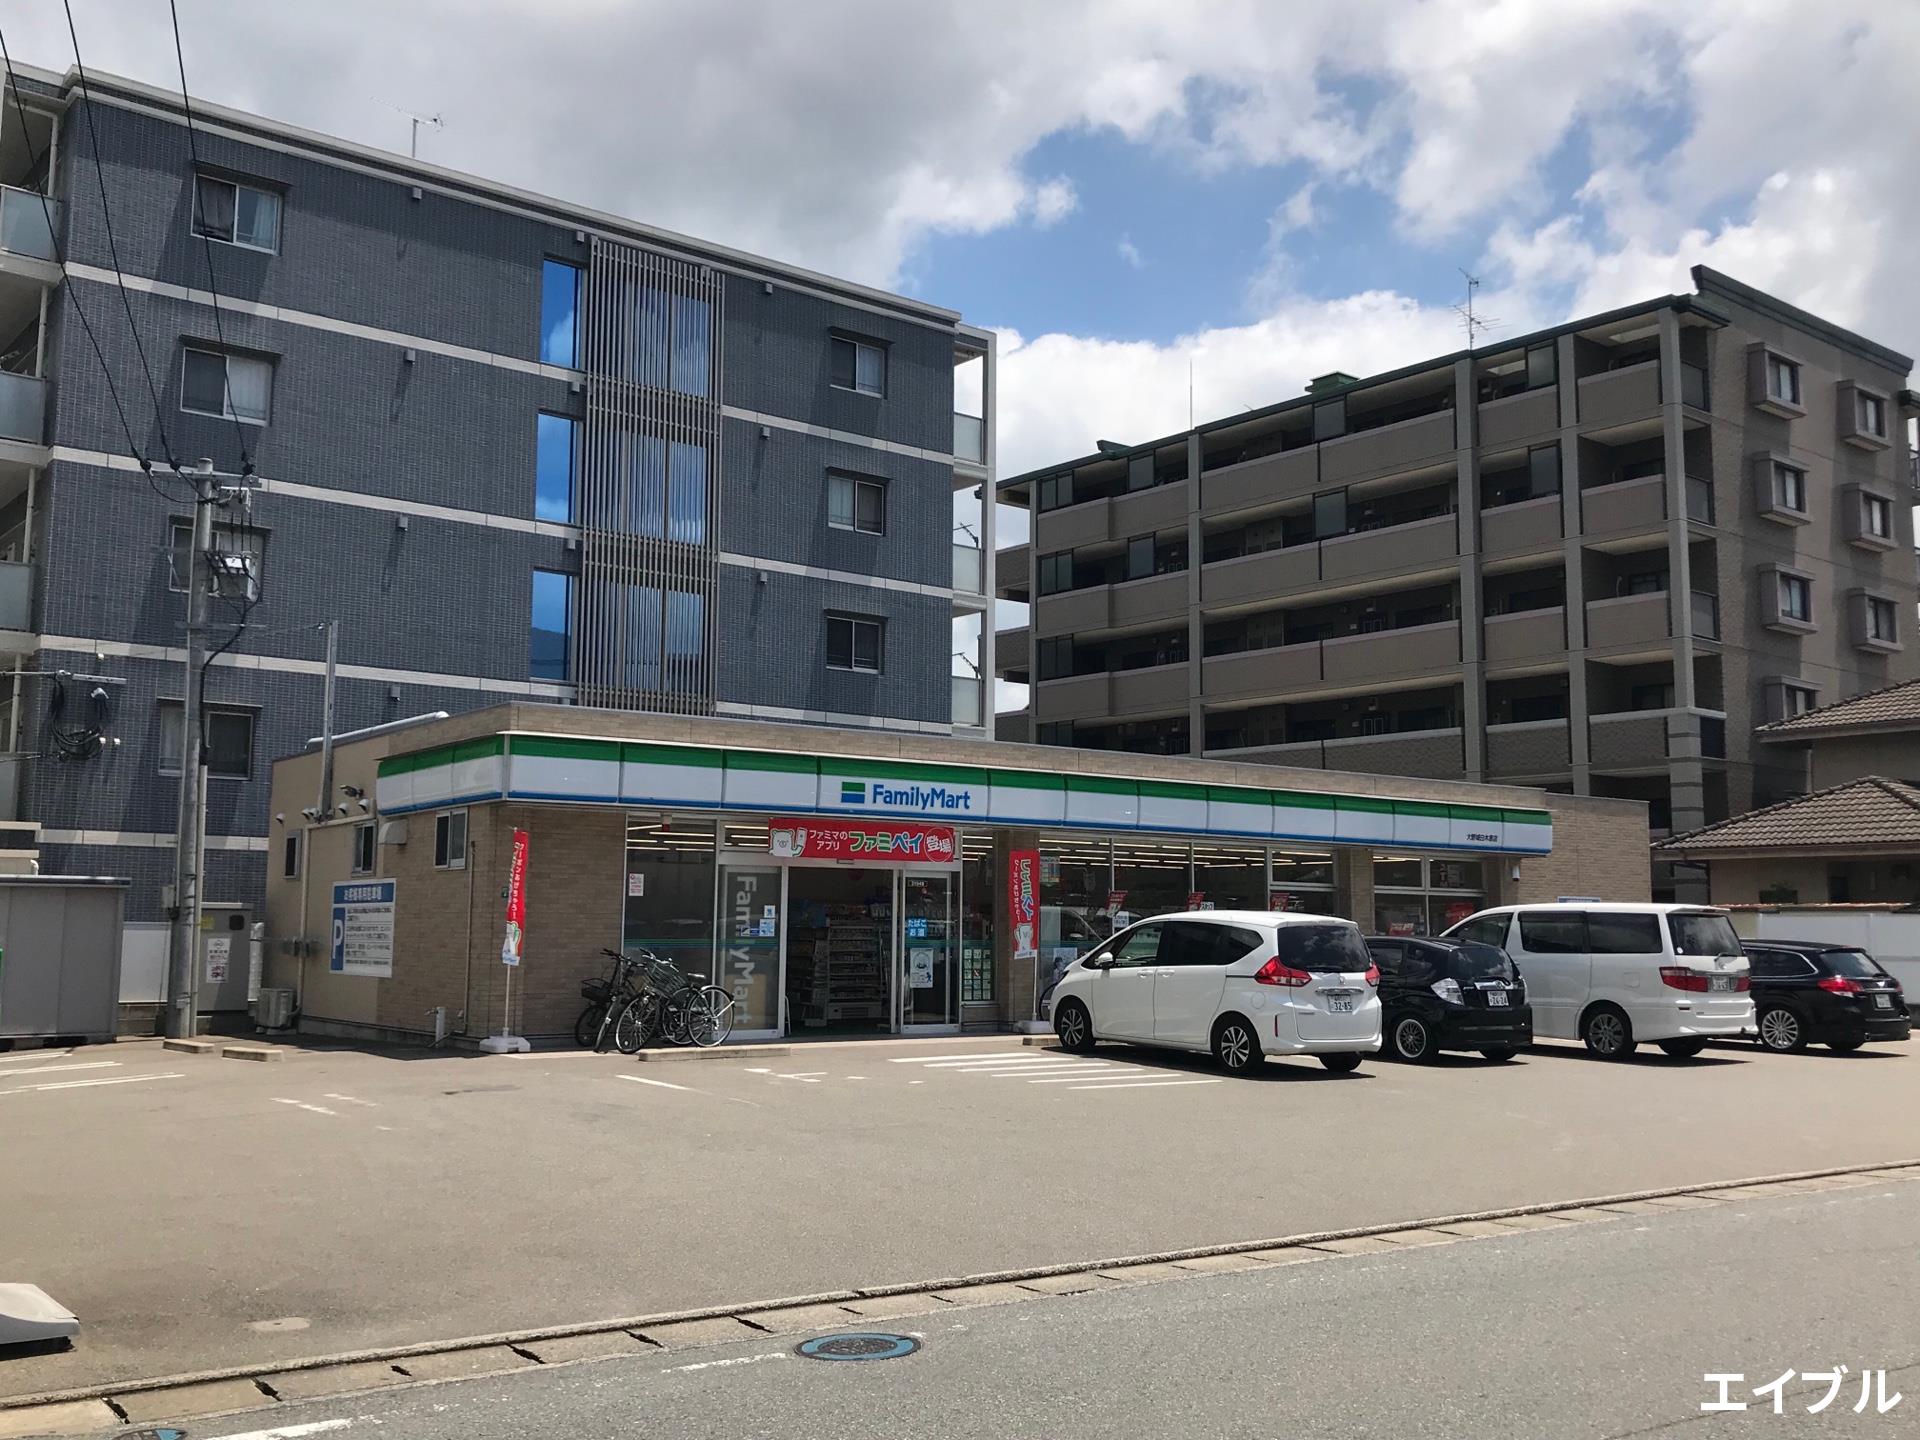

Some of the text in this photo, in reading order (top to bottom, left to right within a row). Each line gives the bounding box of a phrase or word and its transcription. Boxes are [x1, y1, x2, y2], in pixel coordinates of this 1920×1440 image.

[872, 783, 971, 811] FamilyMart
[809, 829, 848, 841] ファミマの
[816, 840, 840, 851] アプリ
[849, 831, 924, 854] ファミペイ
[926, 835, 952, 854] 登場
[332, 919, 344, 960] P
